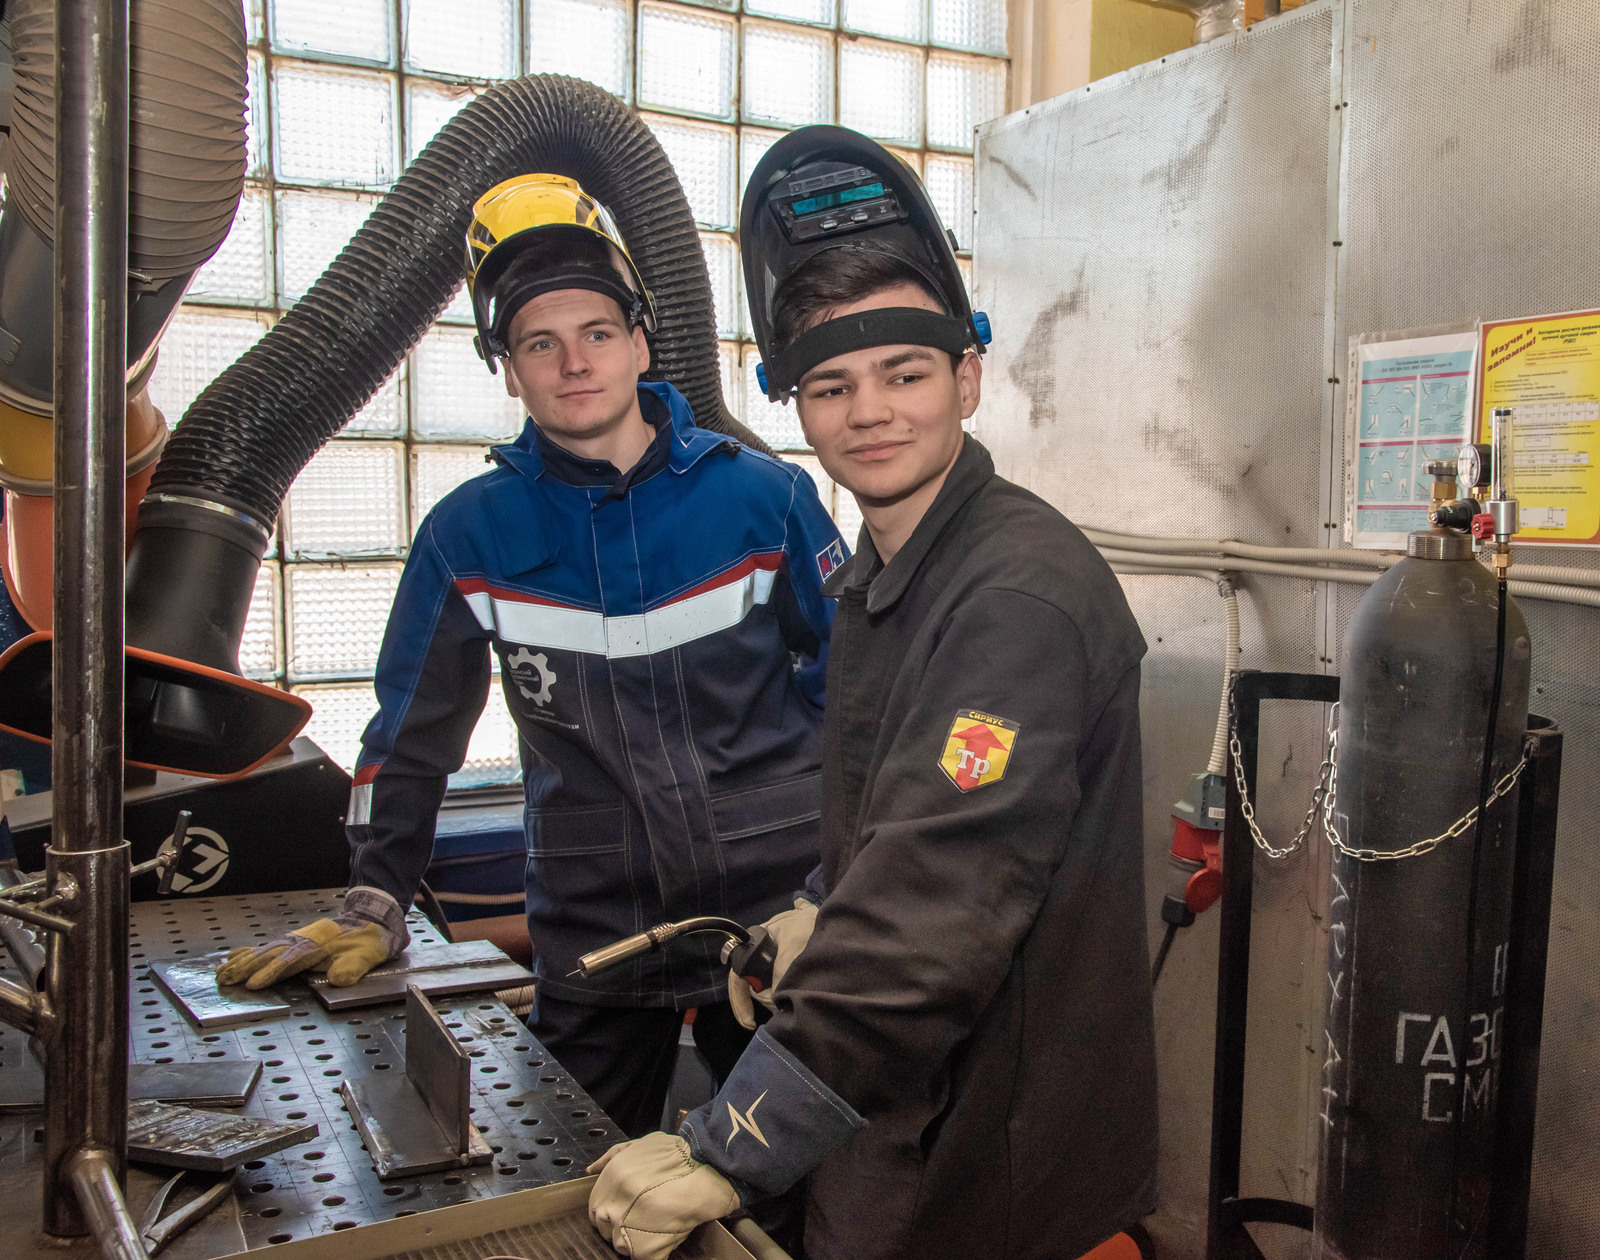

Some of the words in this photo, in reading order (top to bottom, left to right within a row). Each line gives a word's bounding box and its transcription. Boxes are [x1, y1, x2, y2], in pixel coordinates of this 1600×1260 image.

[1487, 336, 1536, 372] запомни!
[1490, 333, 1523, 358] Изучи
[1526, 327, 1533, 336] и
